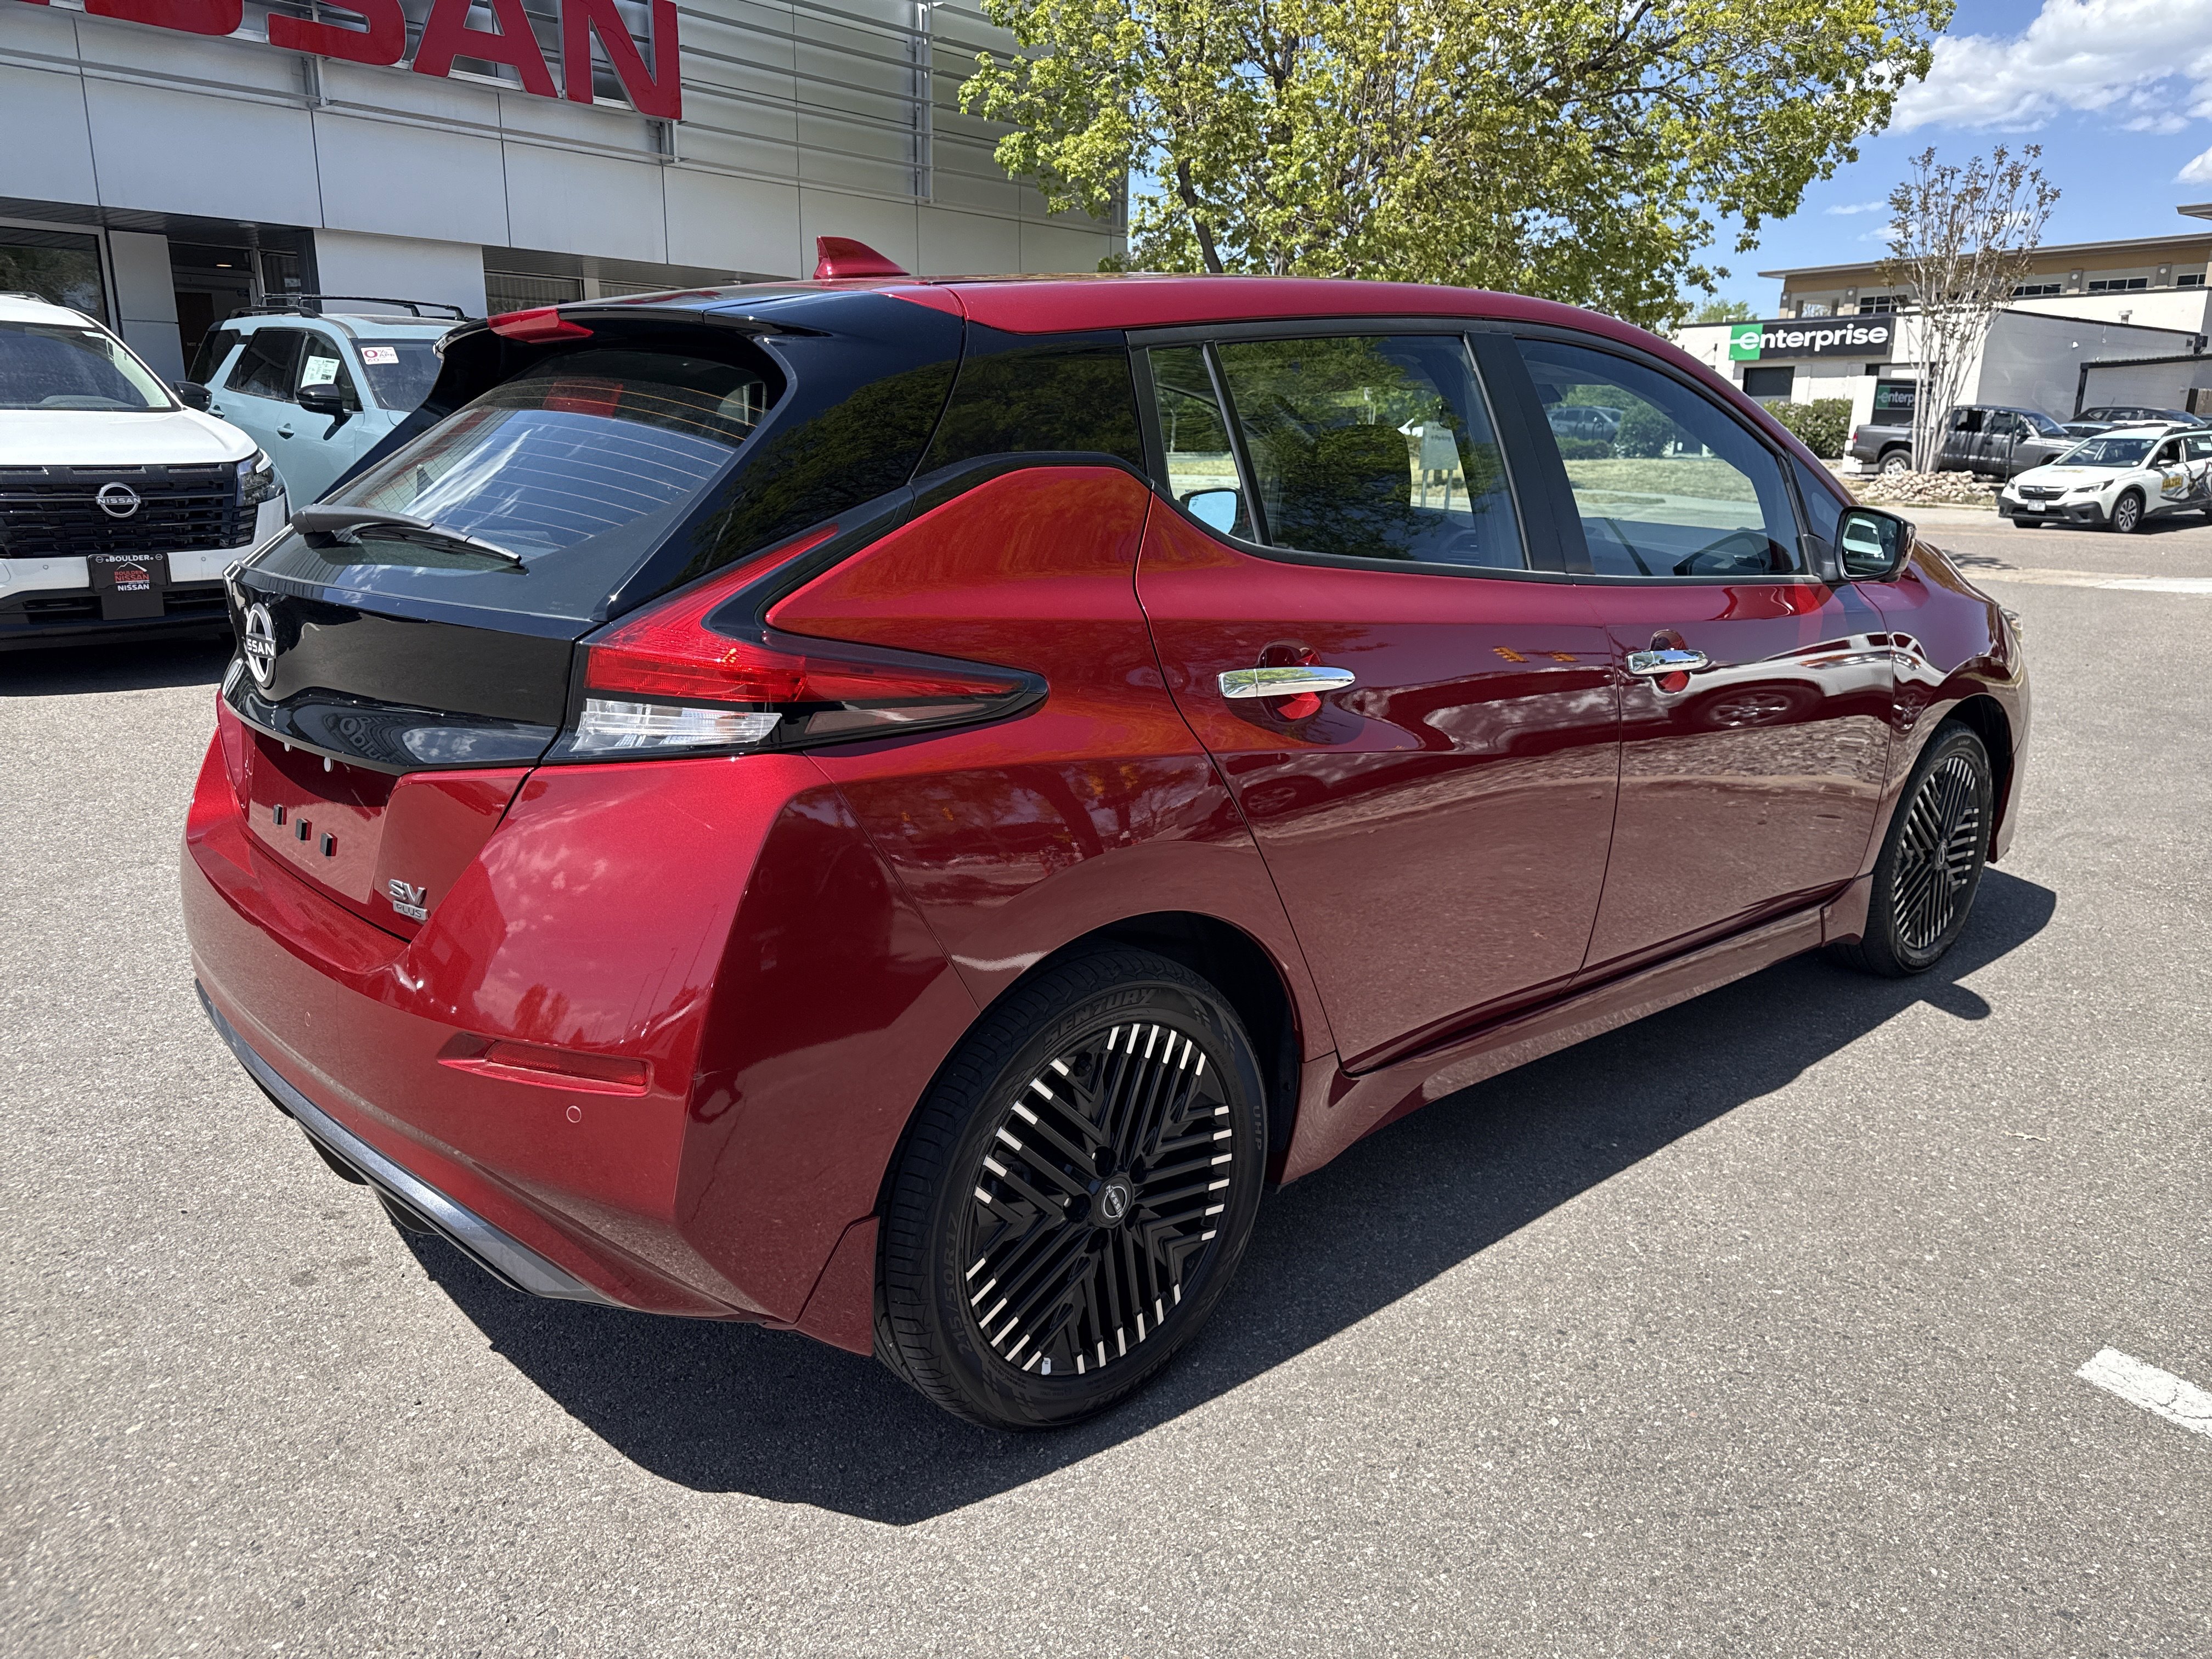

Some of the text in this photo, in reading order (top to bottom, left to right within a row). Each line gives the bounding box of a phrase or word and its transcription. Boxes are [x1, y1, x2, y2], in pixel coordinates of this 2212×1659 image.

[1730, 324, 1888, 352] enterprise
[117, 583, 150, 591] NISSAN
[247, 638, 275, 656] SSAN
[388, 879, 426, 905] SV
[396, 904, 422, 918] PLUS
[1044, 988, 1158, 1053] SENTURY
[1252, 1105, 1263, 1151] UHP
[1105, 1184, 1123, 1218] NISSAN
[943, 1211, 973, 1355] 215/50R17
